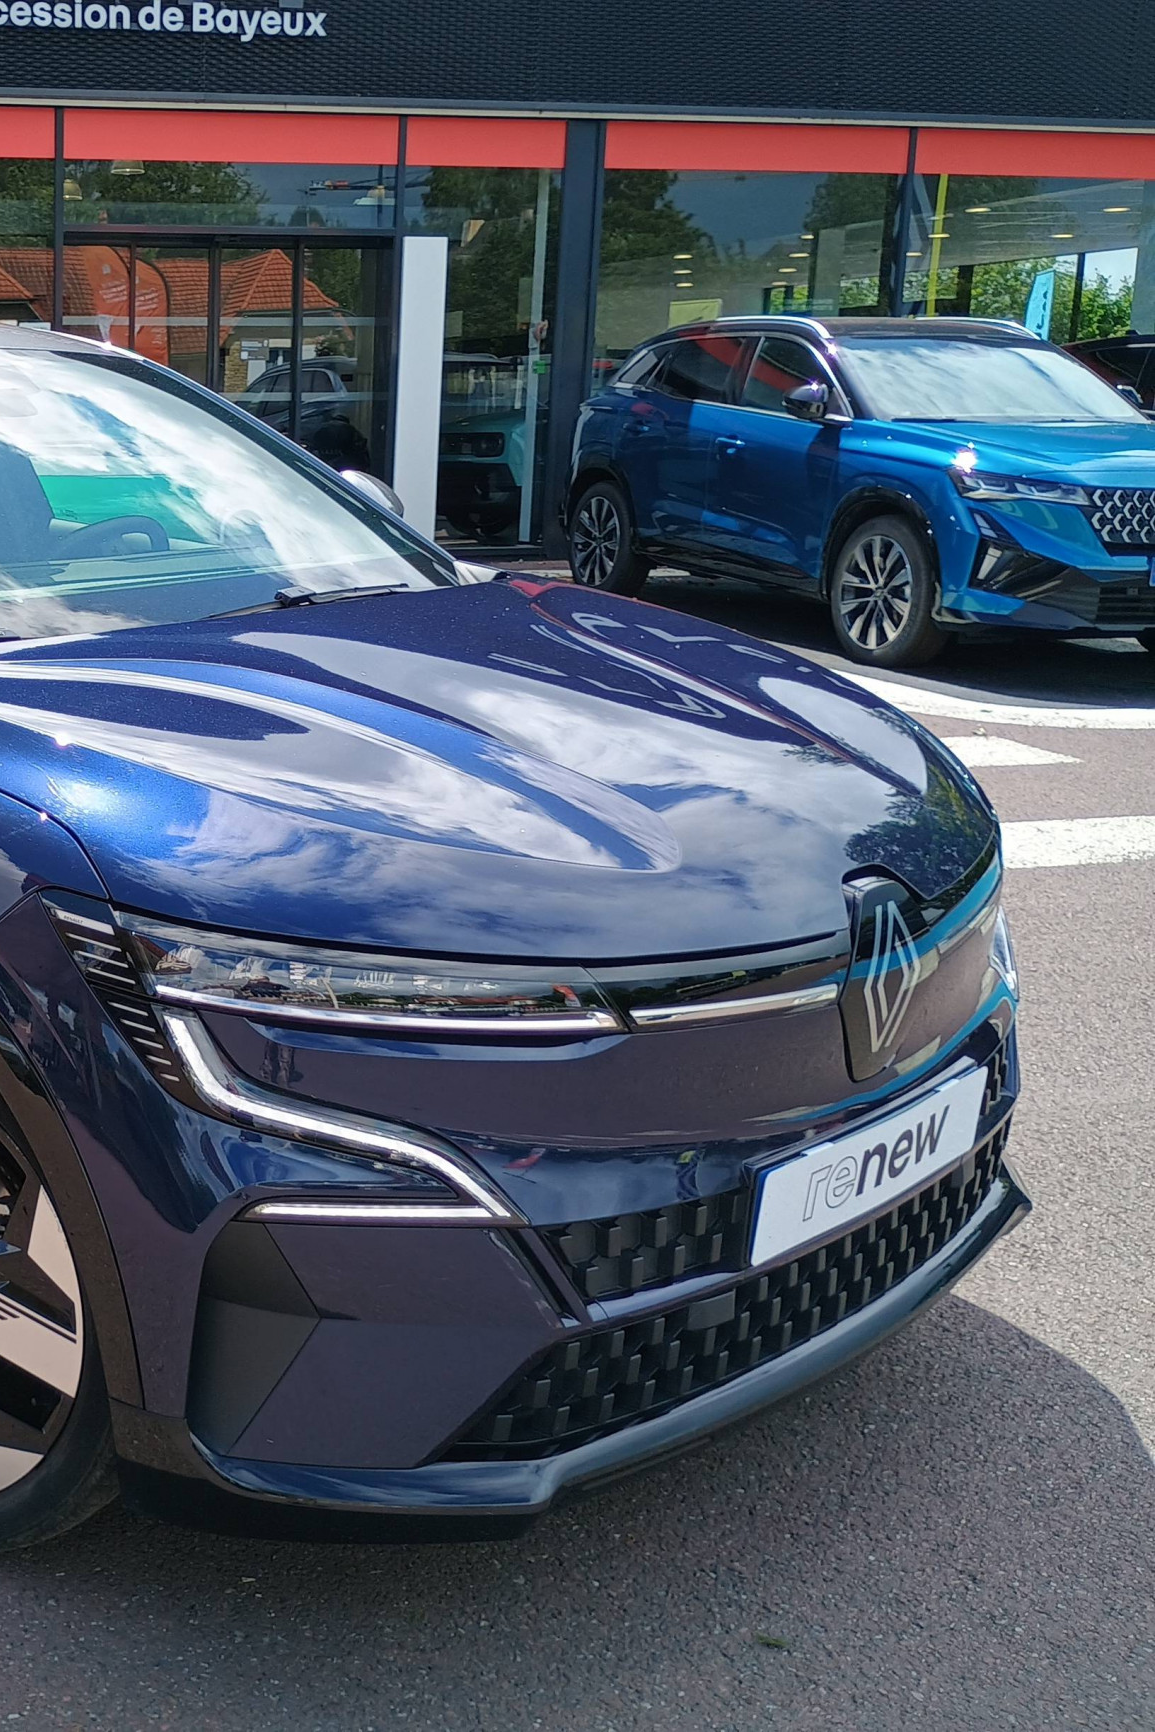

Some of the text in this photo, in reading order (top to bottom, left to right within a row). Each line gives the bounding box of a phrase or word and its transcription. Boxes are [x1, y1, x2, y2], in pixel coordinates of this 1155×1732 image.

[138, 0, 185, 32] de
[192, 2, 328, 42] Bayeux
[802, 1104, 951, 1222] renew
